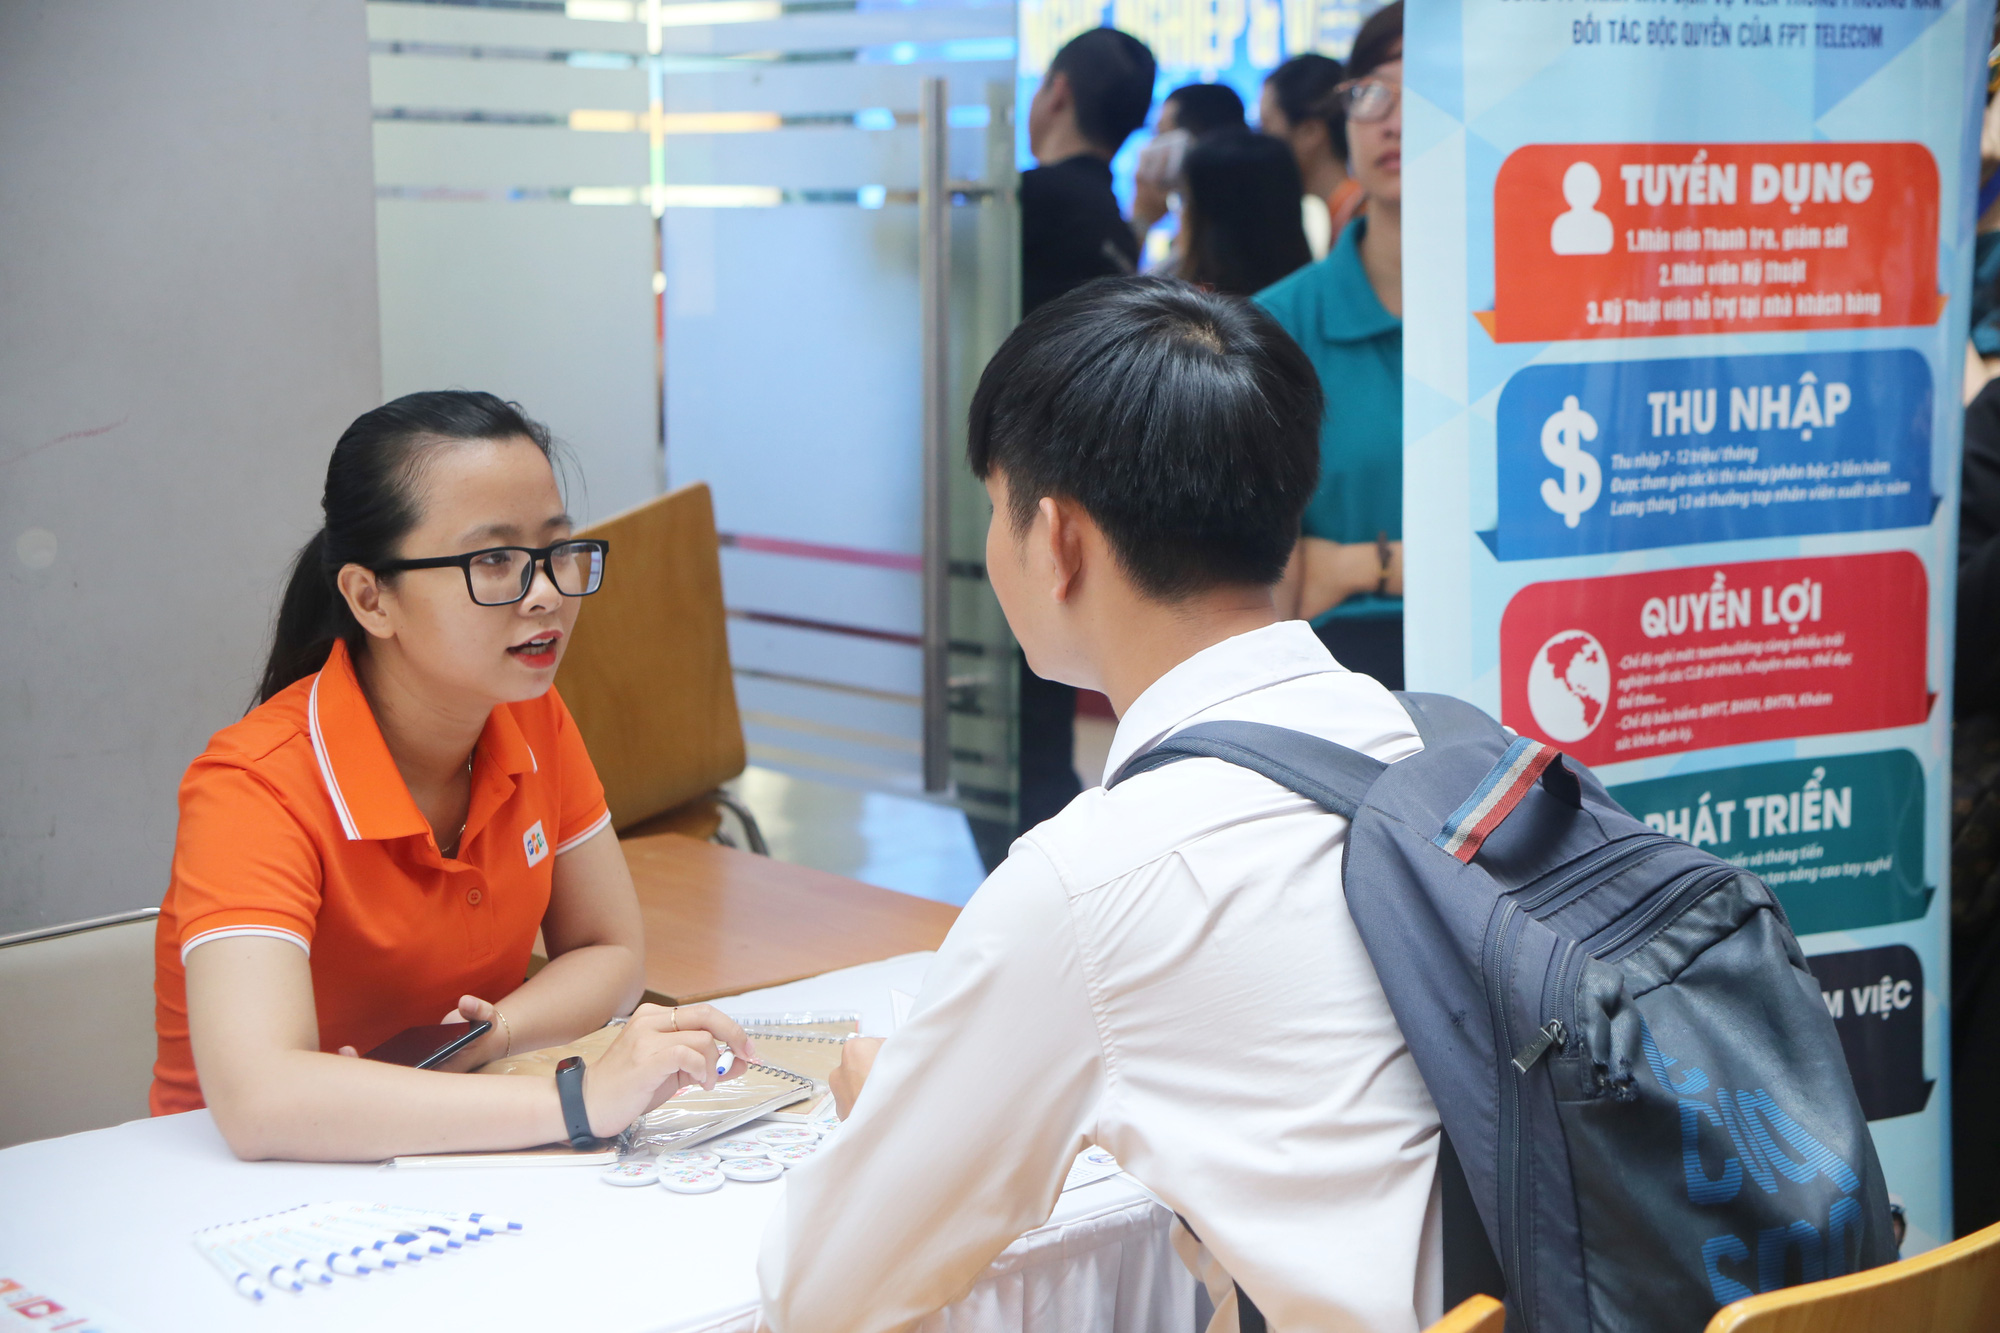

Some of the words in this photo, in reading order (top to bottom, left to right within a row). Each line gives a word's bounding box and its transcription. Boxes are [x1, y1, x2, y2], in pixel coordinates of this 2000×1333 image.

[1573, 12, 1601, 45] ĐỐI
[1608, 15, 1641, 45] TÁC
[1647, 14, 1677, 48] ĐỘC
[1738, 15, 1772, 47] CỦA
[1779, 23, 1807, 47] FPT
[1815, 23, 1883, 48] TELECOM
[1620, 149, 1737, 206] TUYỂN
[1751, 160, 1873, 214] DỤNG
[1647, 389, 1717, 437] THU
[1729, 371, 1851, 442] NHẬP
[1676, 449, 1690, 465] 12
[1640, 570, 1751, 637] QUYỀN
[1762, 577, 1823, 634] LỢI
[1645, 791, 1736, 846] PHÁT
[1744, 766, 1852, 839] TRIỂN
[1851, 975, 1913, 1021] VIỆC
